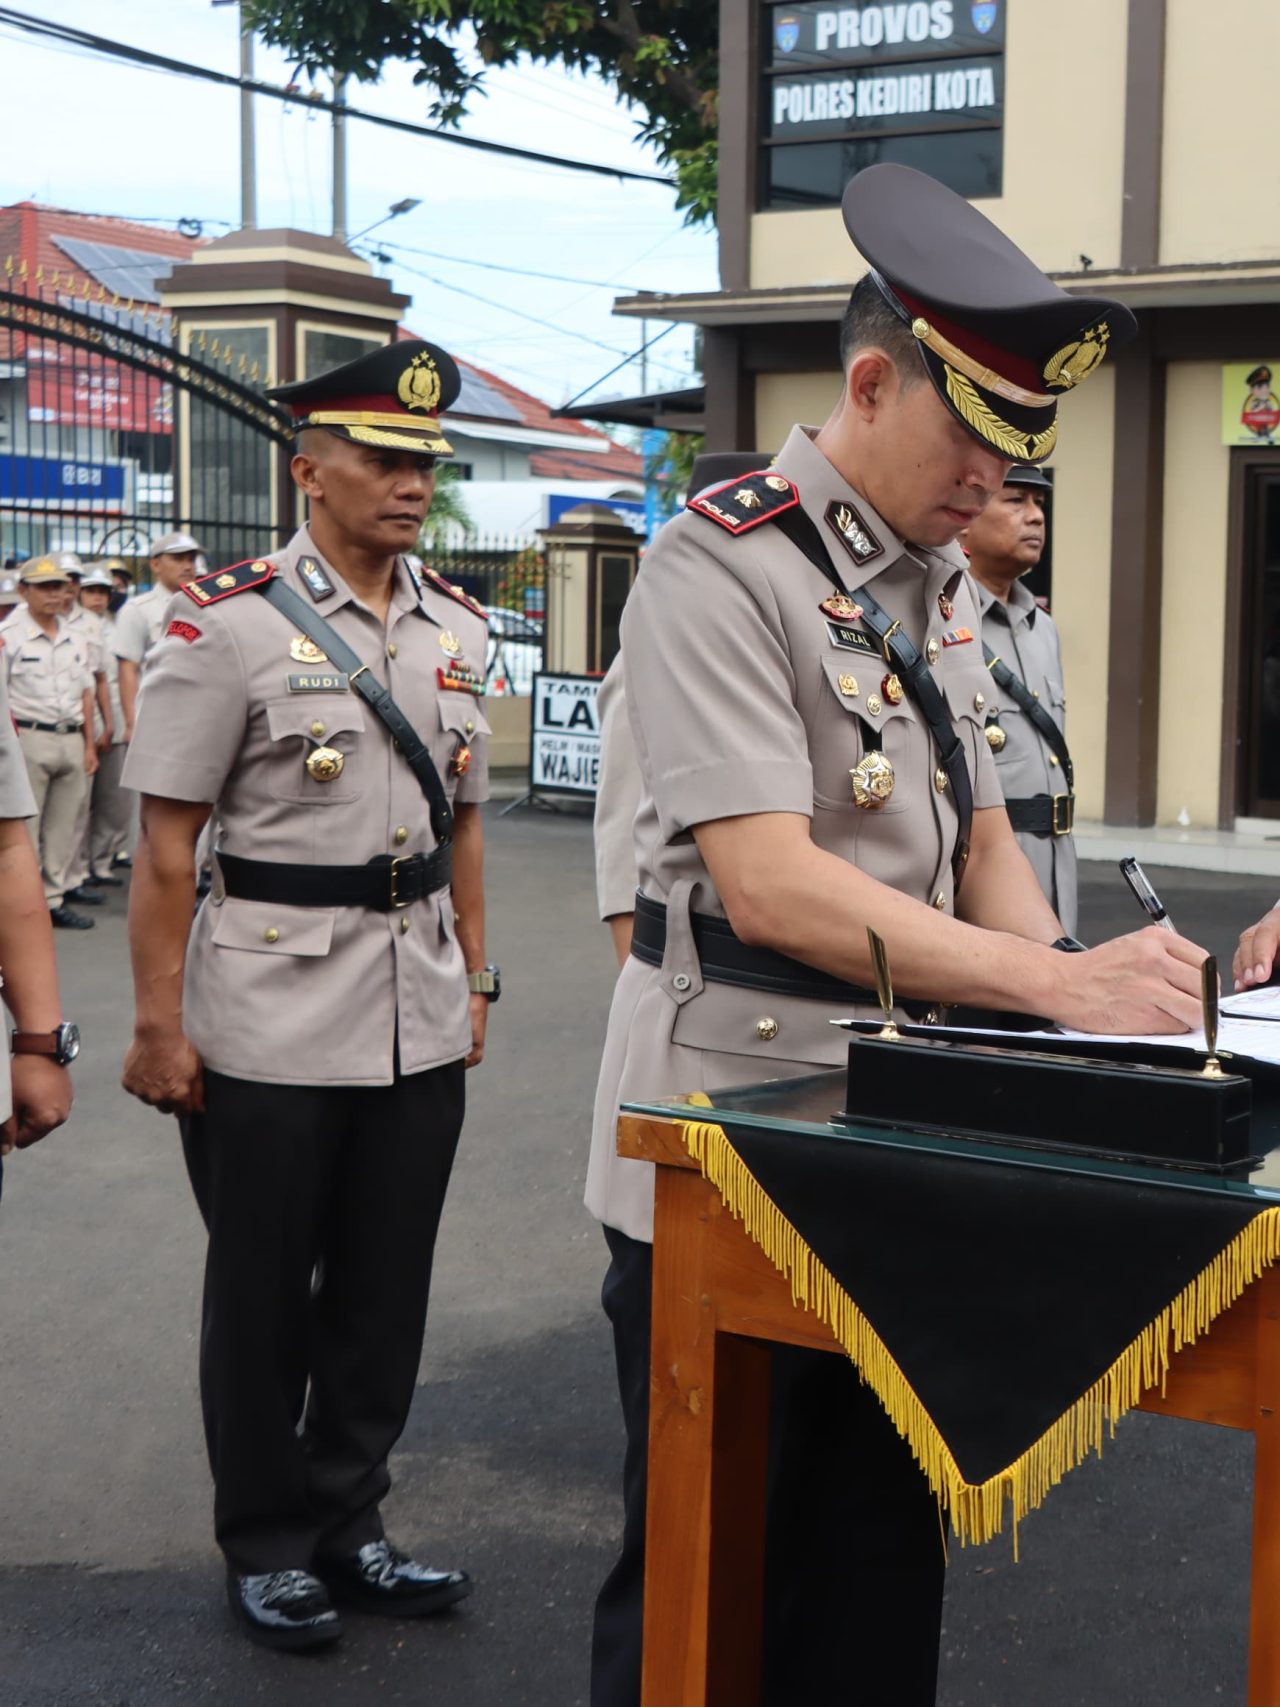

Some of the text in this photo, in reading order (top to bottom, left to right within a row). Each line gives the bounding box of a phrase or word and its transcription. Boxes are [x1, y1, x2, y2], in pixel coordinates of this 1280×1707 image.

[815, 1, 954, 51] PROVOS
[773, 68, 995, 124] POLRES KEDIRI KOTA
[698, 499, 741, 527] POLISI
[840, 629, 871, 647] RIZAL
[299, 677, 339, 688] RUDI
[543, 682, 598, 696] TAM
[543, 697, 594, 731] LA
